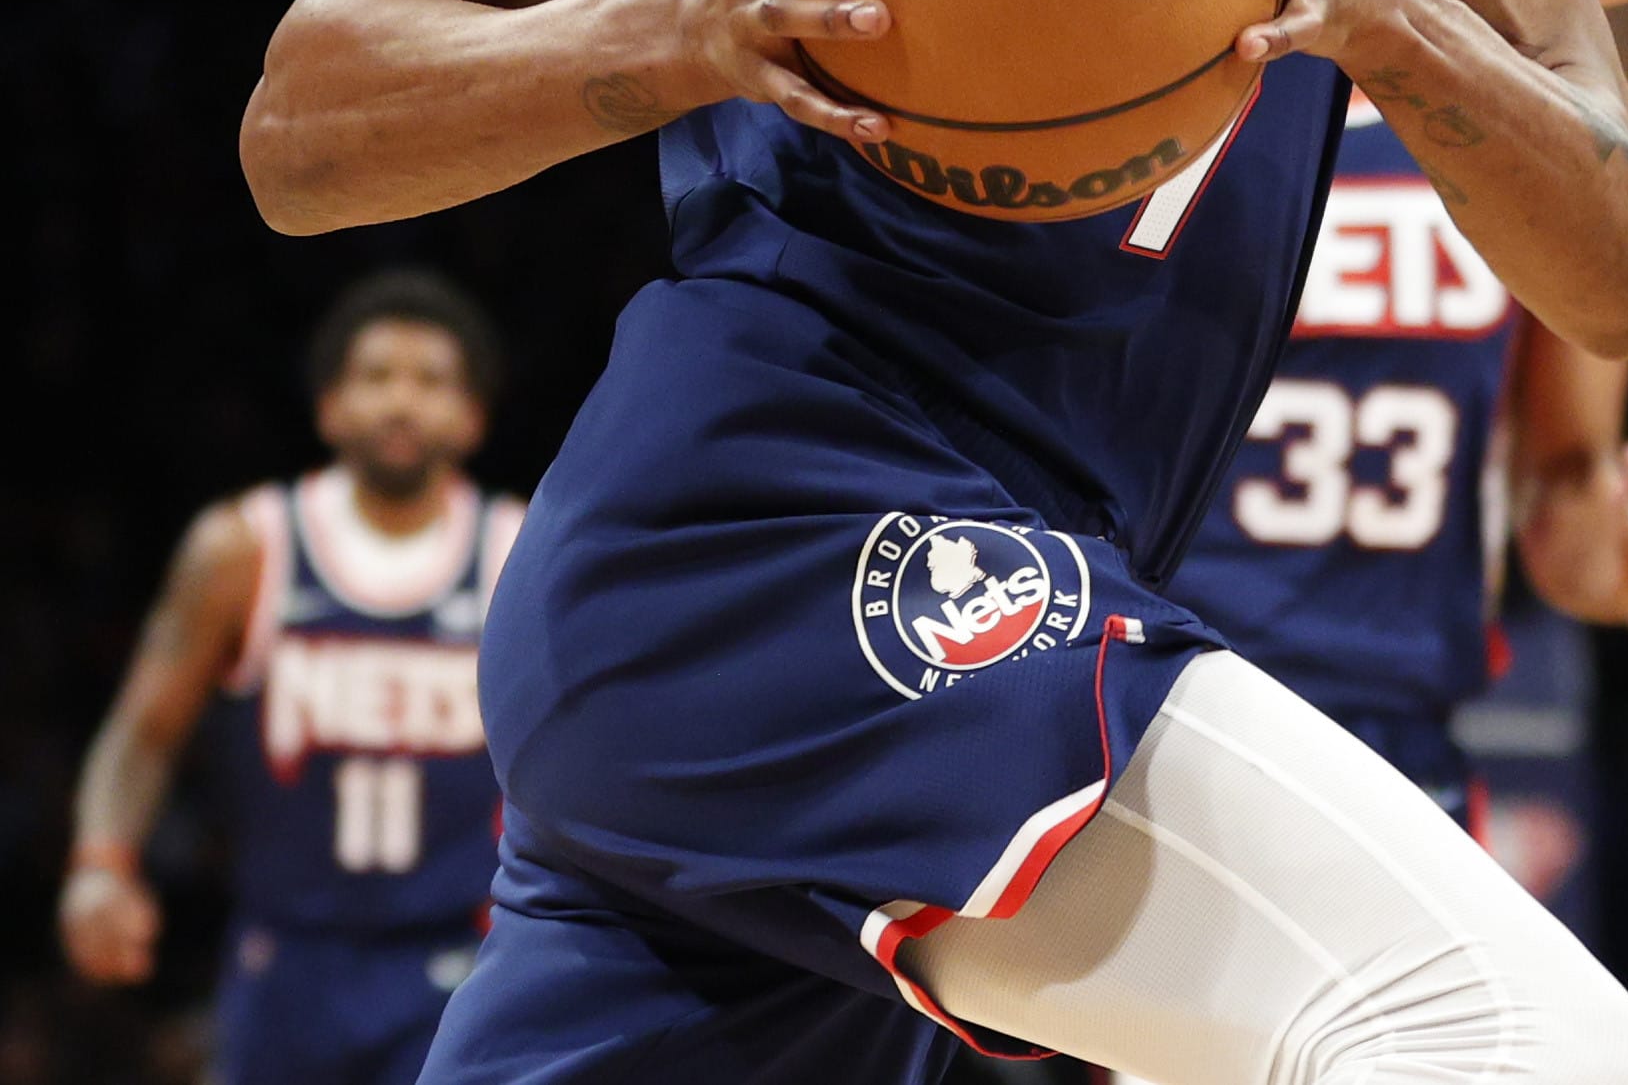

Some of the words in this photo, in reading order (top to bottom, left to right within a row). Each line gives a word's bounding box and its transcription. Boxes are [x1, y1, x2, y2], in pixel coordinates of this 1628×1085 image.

[861, 137, 1186, 209] Wilson
[1288, 175, 1515, 340] ETS
[1234, 378, 1460, 551] 33
[911, 566, 1047, 664] Nets
[333, 757, 424, 875] 11
